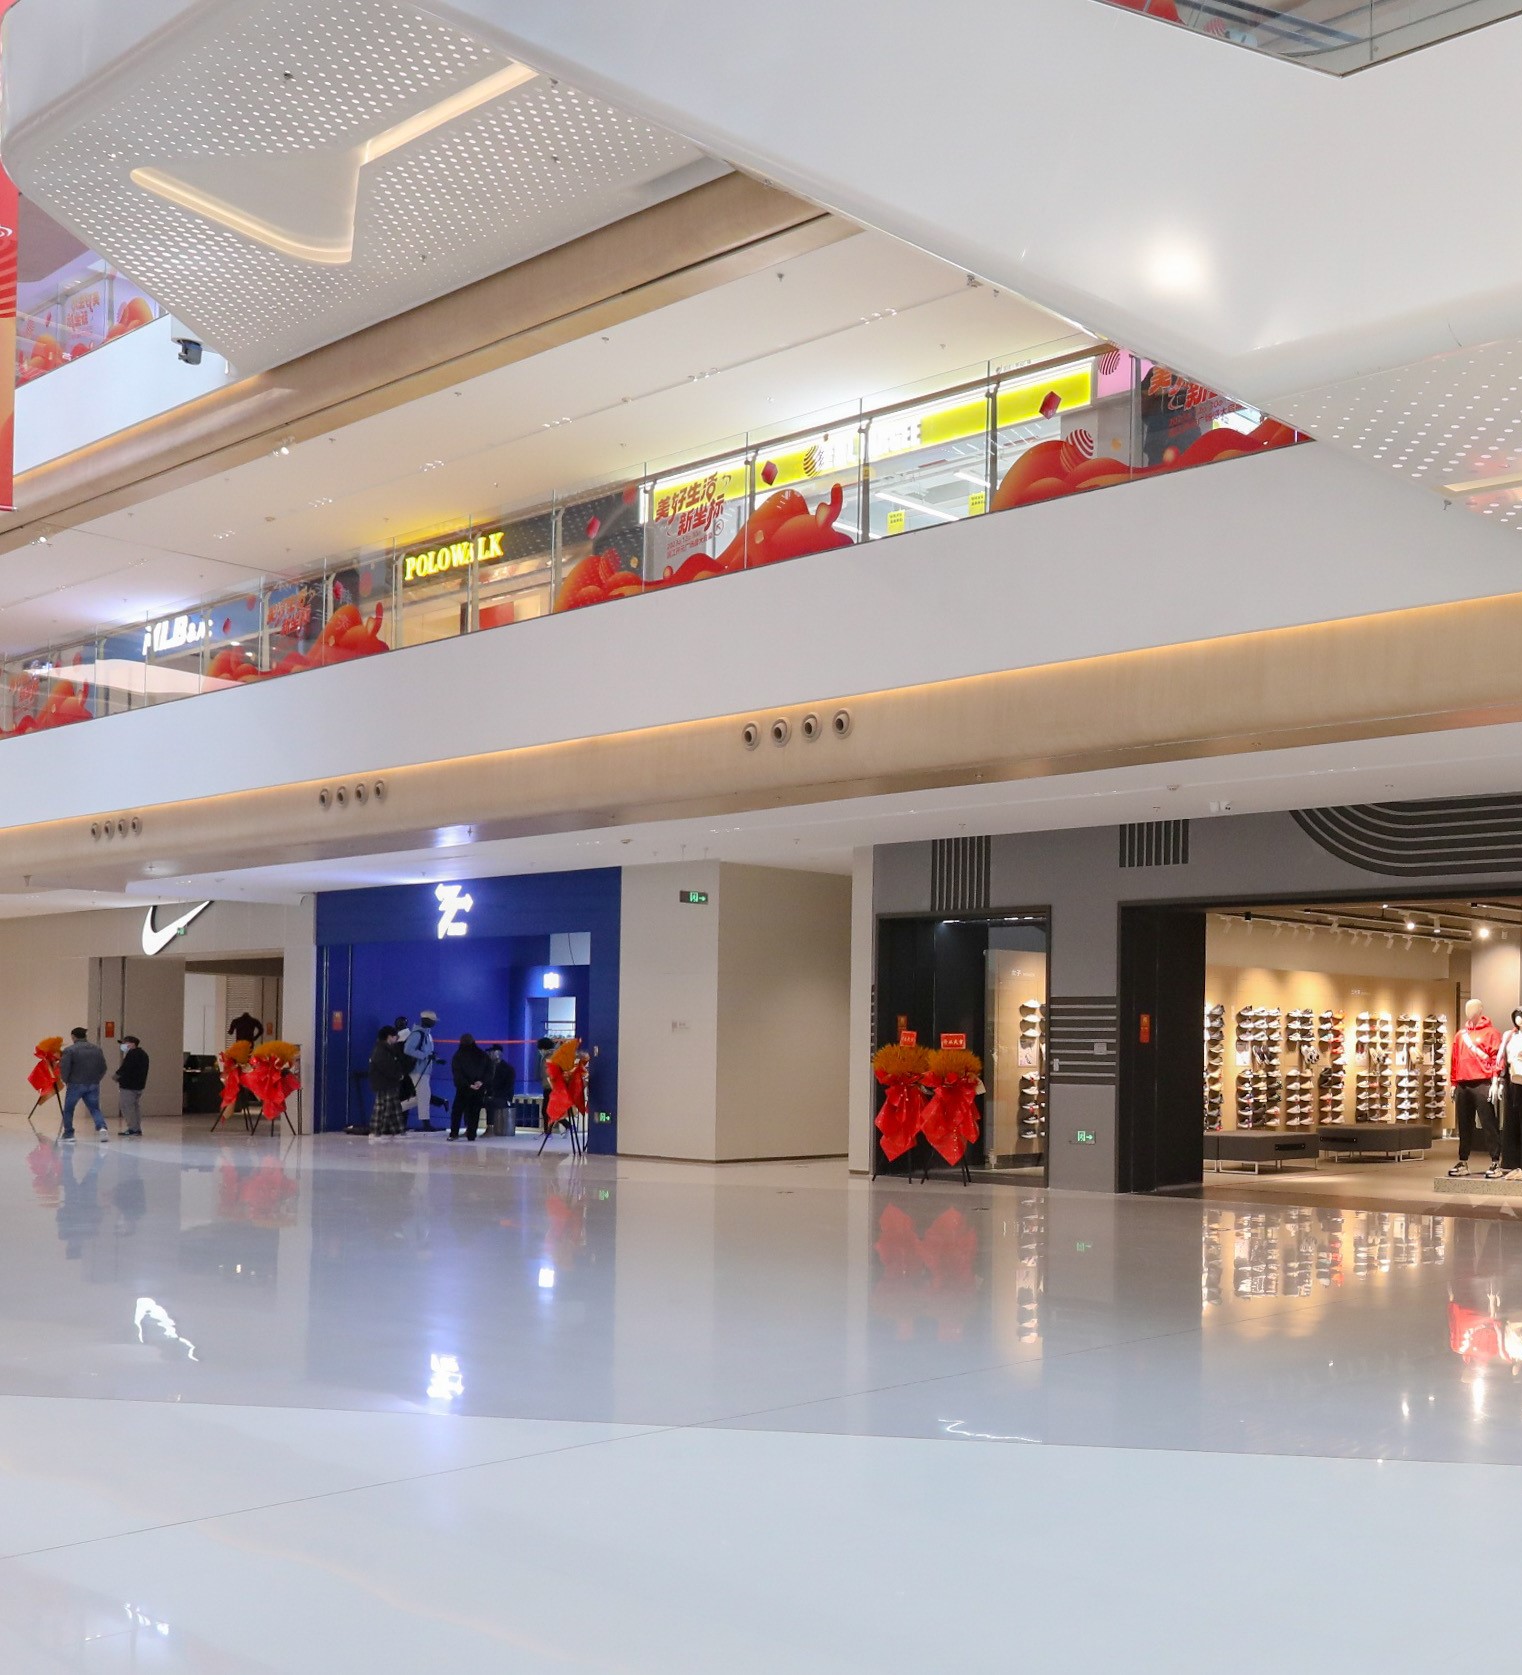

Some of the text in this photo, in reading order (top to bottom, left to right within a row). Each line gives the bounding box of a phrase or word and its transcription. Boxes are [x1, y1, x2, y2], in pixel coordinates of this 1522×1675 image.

[655, 472, 718, 525] 美好生活
[677, 493, 725, 536] 新坐标
[404, 532, 505, 581] POLOWALK
